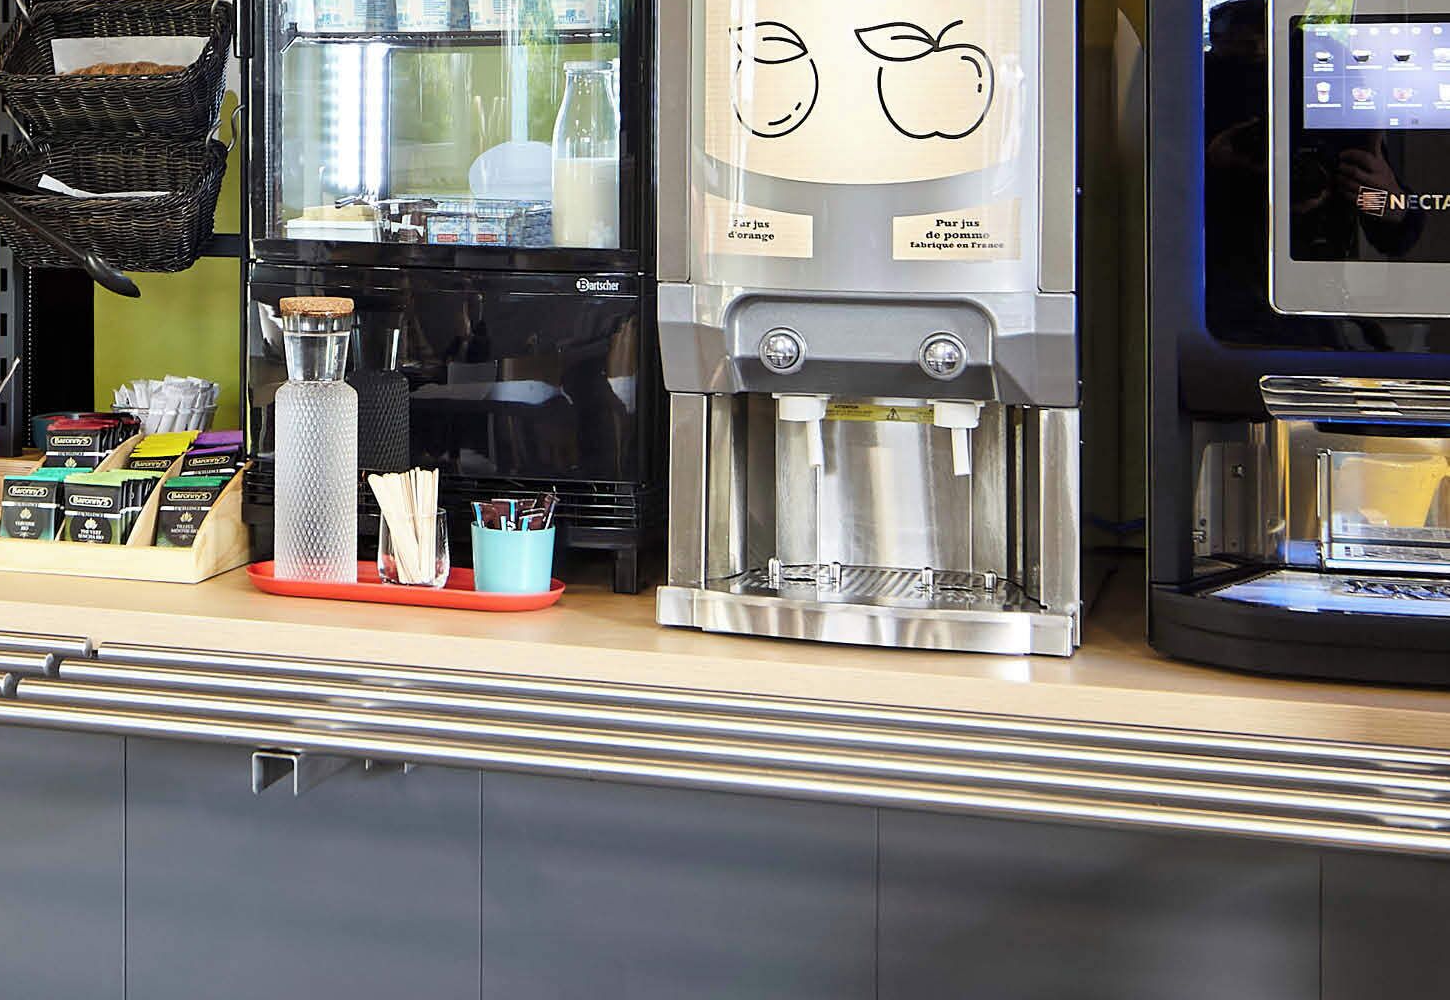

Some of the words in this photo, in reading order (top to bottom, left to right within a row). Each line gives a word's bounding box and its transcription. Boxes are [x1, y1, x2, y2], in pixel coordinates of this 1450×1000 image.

[752, 218, 770, 231] jus
[935, 219, 958, 227] Pur
[960, 218, 980, 230] jus
[727, 230, 775, 243] d'orange
[925, 230, 941, 239] de
[575, 277, 620, 292] Bartscher
